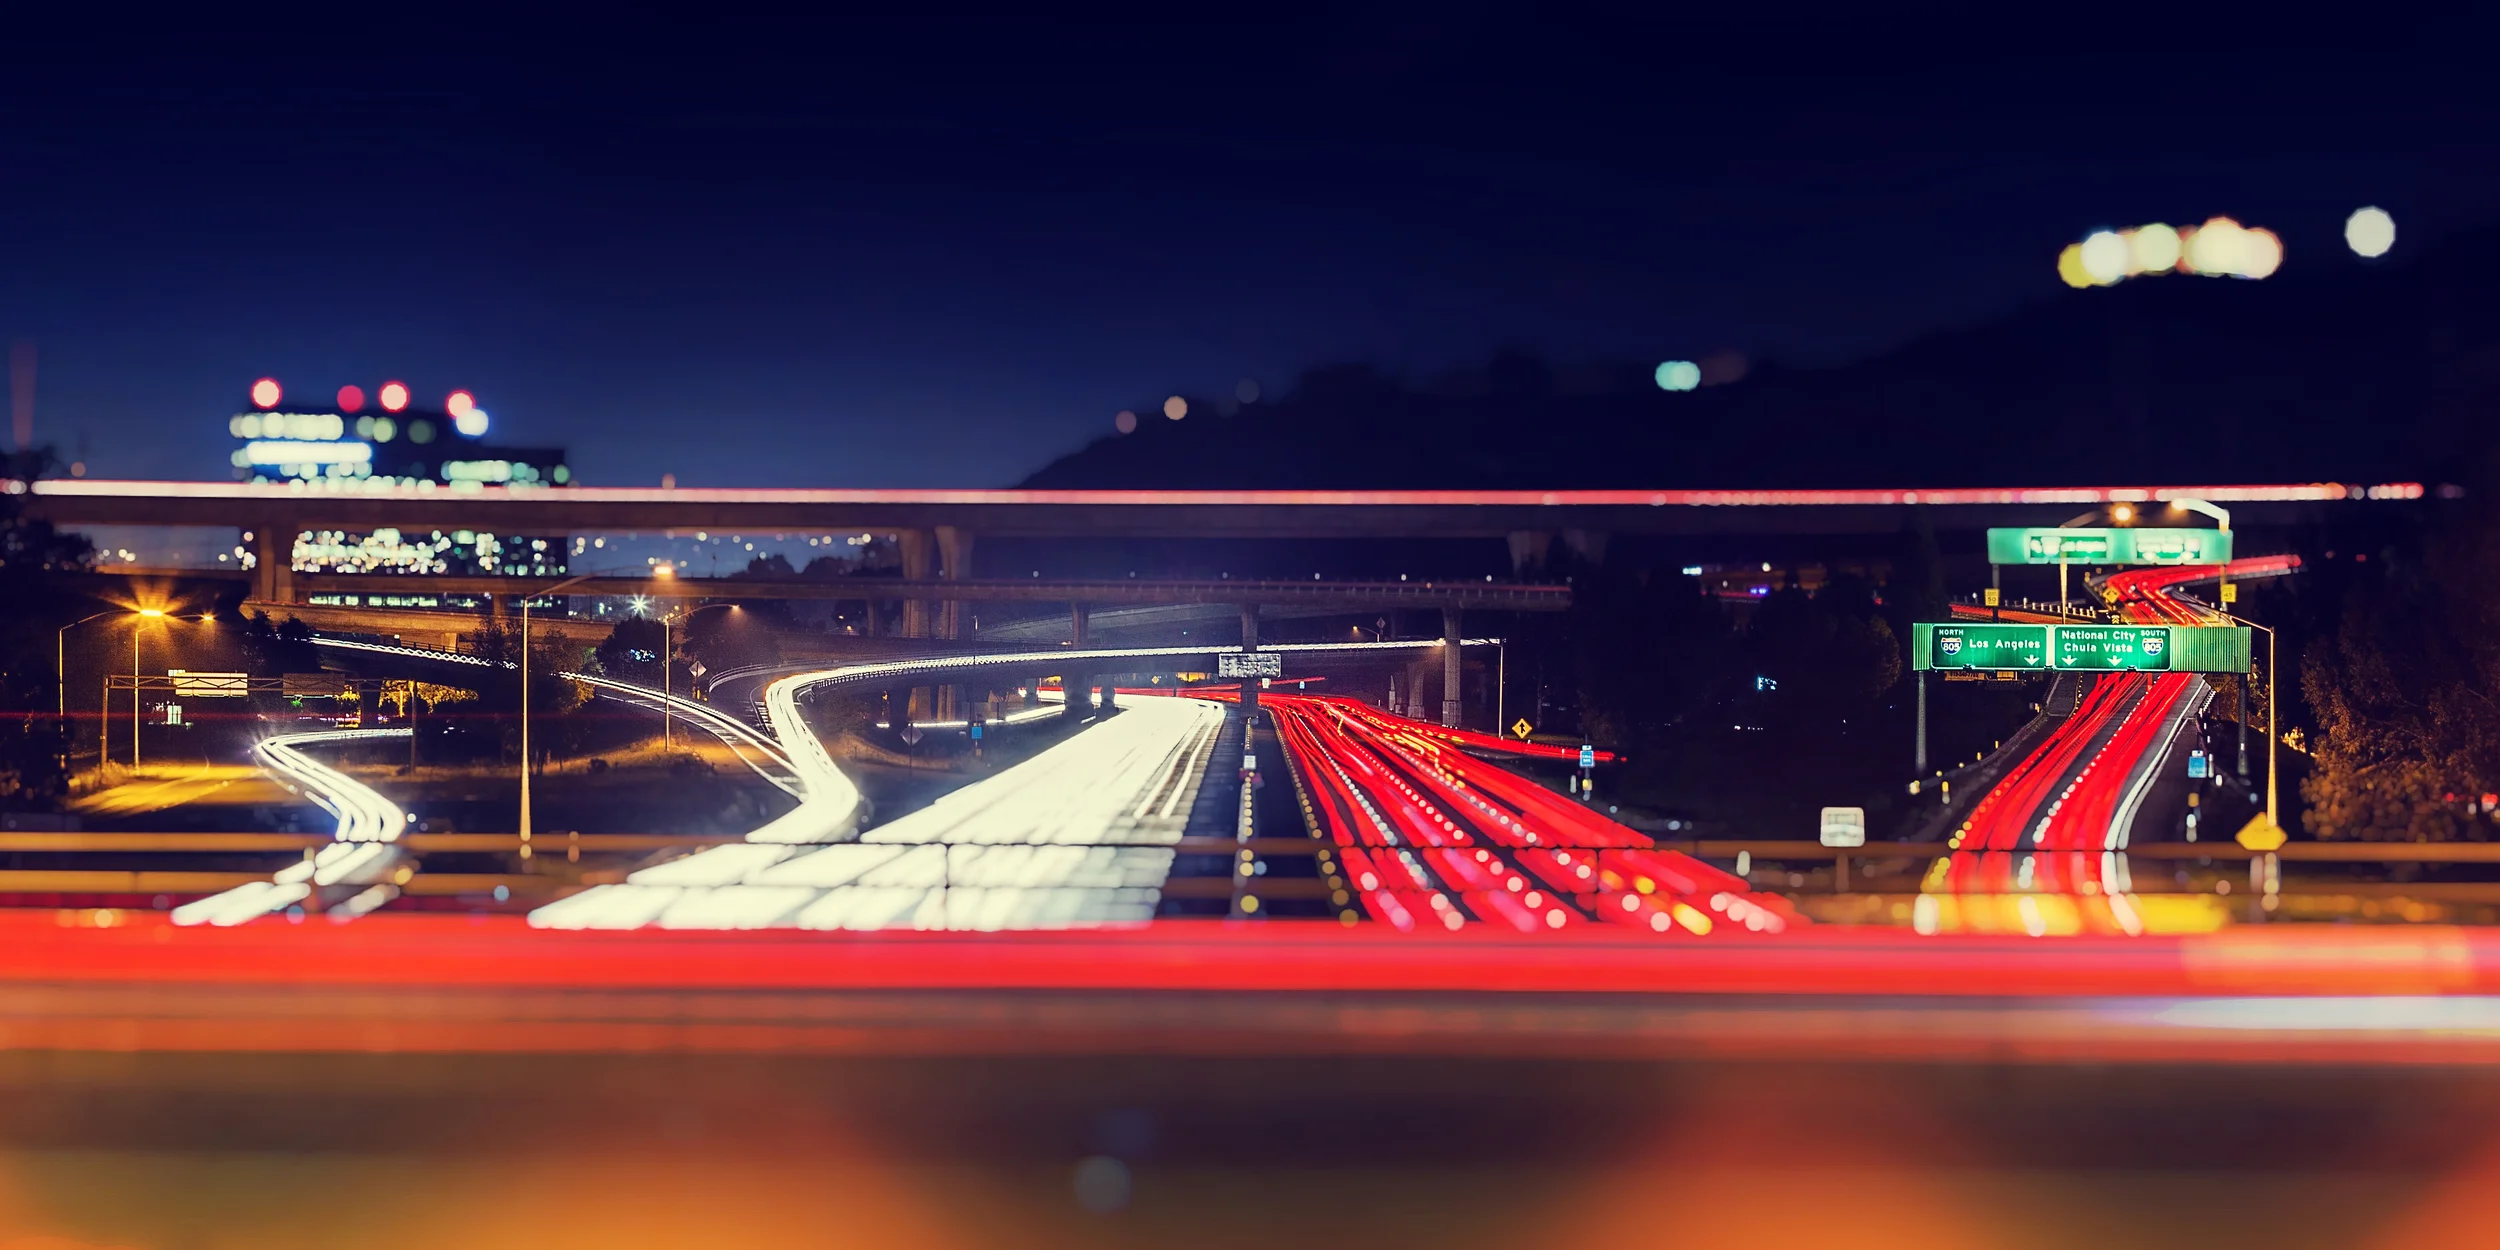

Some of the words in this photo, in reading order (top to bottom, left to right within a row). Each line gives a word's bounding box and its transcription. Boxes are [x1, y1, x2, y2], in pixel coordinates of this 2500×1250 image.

[2061, 630, 2107, 640] National
[2112, 631, 2136, 642] City
[1943, 642, 1961, 651] 805
[1969, 639, 1989, 648] Los
[1995, 639, 2040, 651] Angeles
[2063, 643, 2097, 652] Chula
[2103, 643, 2133, 652] Vista
[2144, 643, 2162, 652] 805
